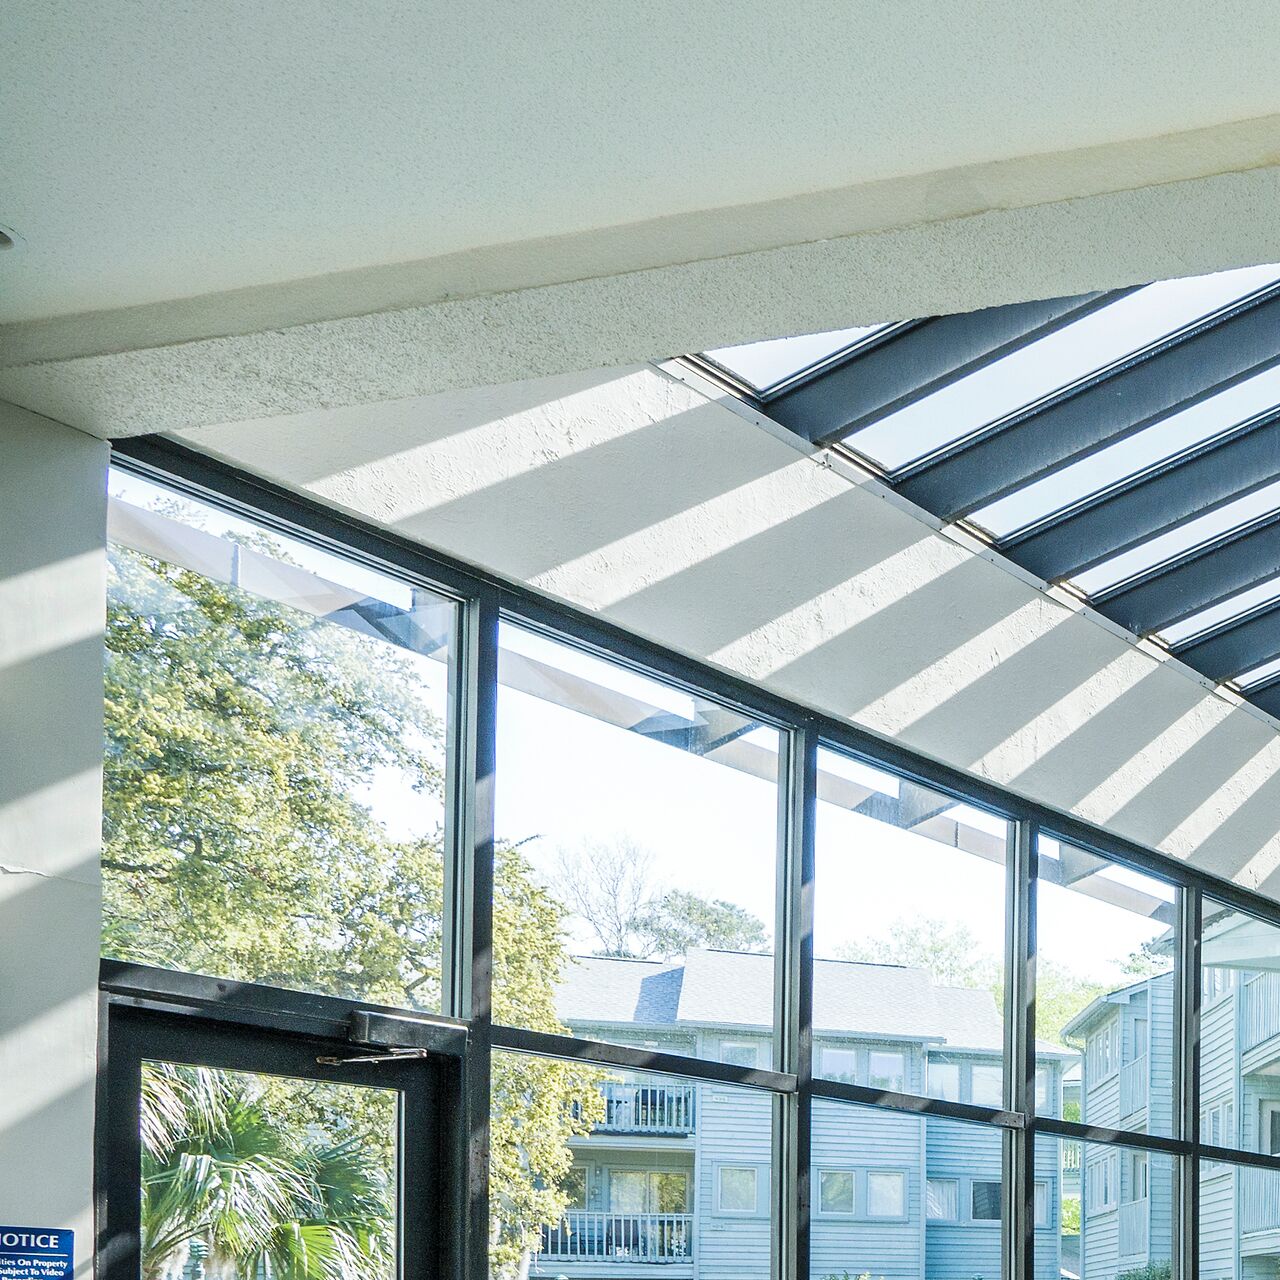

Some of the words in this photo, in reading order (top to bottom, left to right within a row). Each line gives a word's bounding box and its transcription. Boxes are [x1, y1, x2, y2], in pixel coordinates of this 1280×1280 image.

[0, 1233, 59, 1249] OTICE
[17, 1258, 32, 1267] On
[33, 1259, 68, 1269] Property
[29, 1268, 40, 1276] To
[41, 1268, 65, 1277] Video
